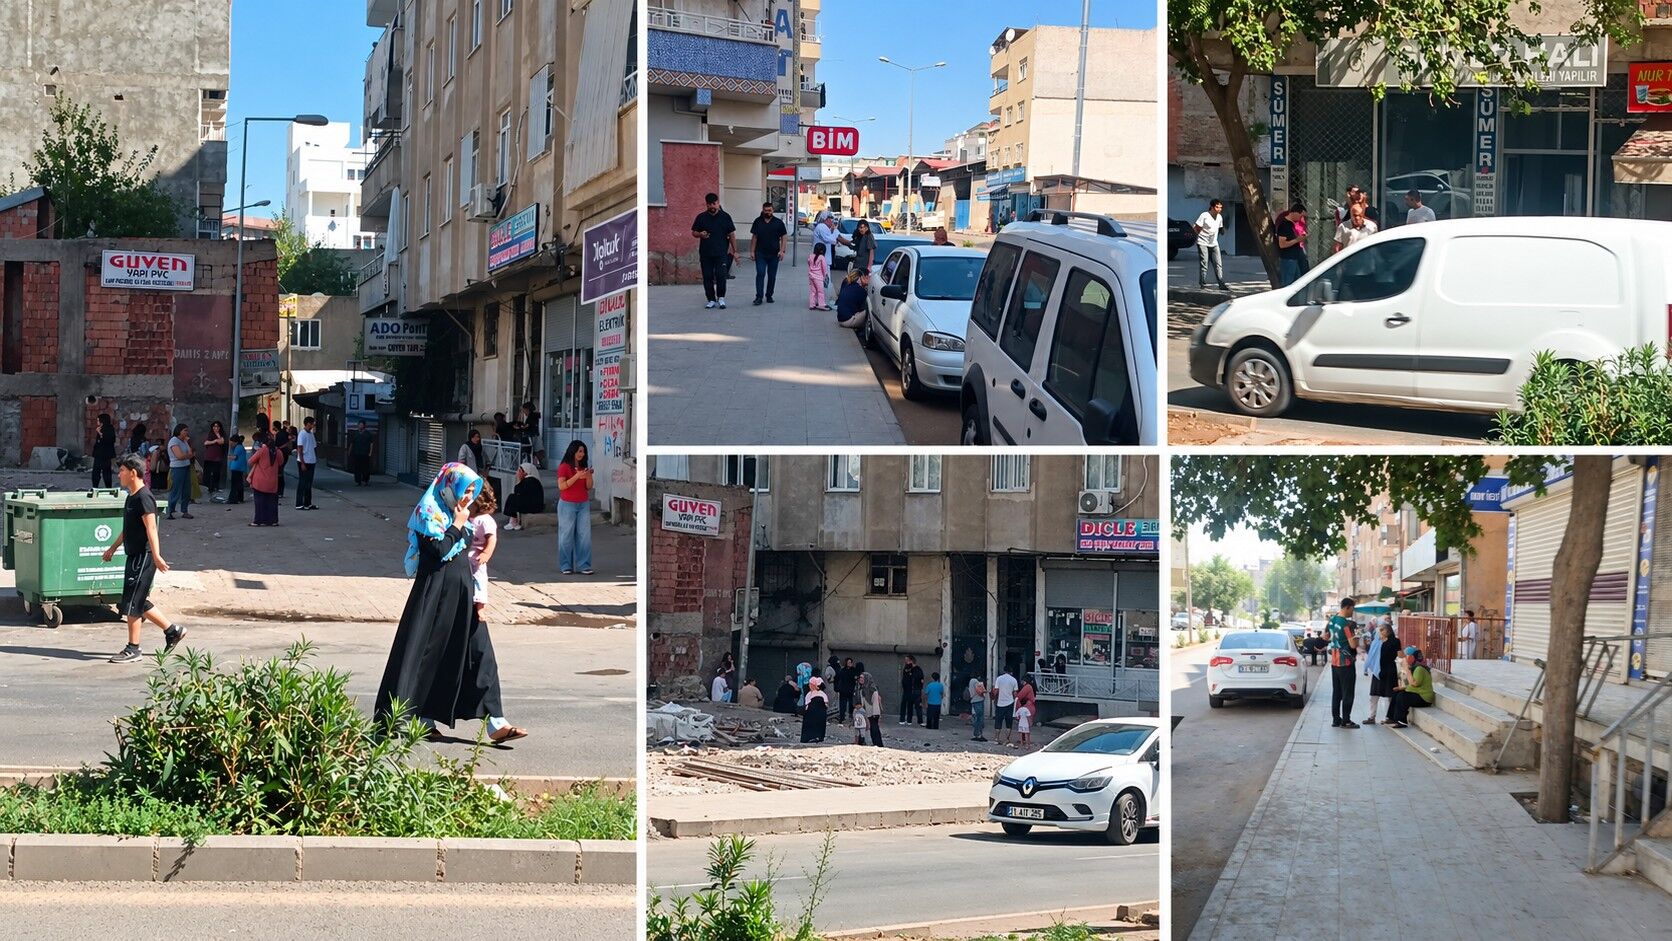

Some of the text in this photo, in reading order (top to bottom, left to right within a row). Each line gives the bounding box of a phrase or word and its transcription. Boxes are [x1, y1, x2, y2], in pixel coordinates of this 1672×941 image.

[1525, 42, 1598, 67] HALI
[1559, 71, 1598, 81] YAPILIR
[1637, 69, 1664, 82] NUR
[1273, 82, 1285, 160] SÜMER
[1478, 88, 1495, 166] SÜMER
[812, 128, 853, 149] BİM
[127, 269, 169, 278] YAPI PVC
[370, 322, 401, 334] ADO
